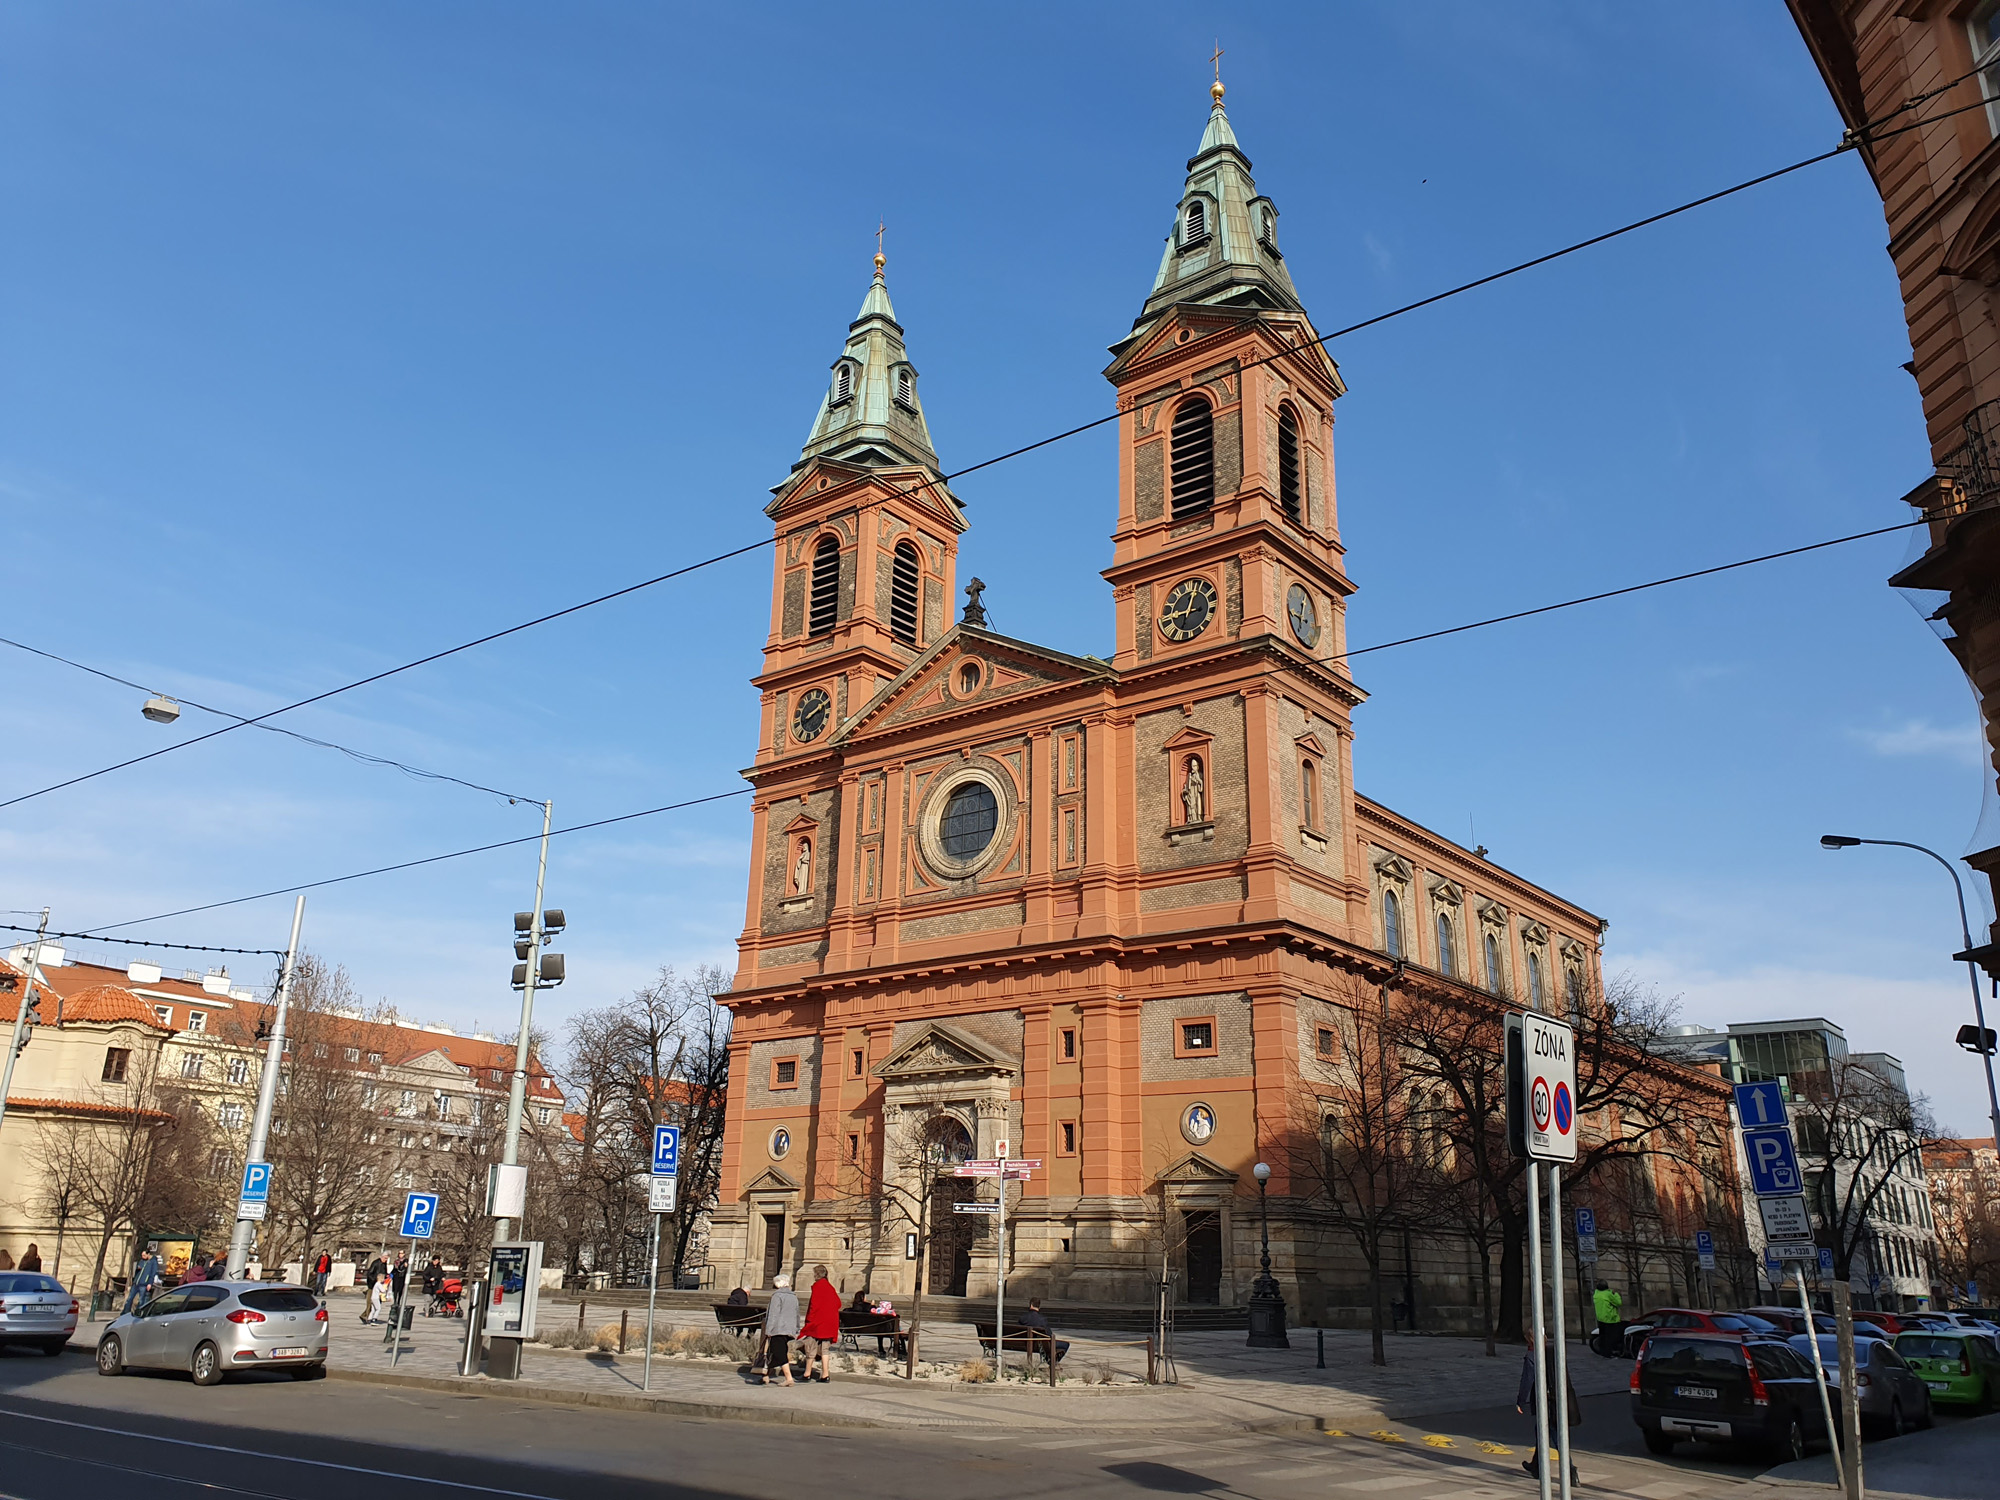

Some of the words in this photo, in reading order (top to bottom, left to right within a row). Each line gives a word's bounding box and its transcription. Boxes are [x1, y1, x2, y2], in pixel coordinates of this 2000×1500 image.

[1534, 1025, 1566, 1062] ZÓNA
[1535, 1090, 1547, 1117] 30
[658, 1131, 674, 1159] P
[1754, 1138, 1782, 1174] P
[247, 1167, 265, 1189] P
[408, 1198, 430, 1223] P
[1579, 1210, 1590, 1226] P
[1699, 1233, 1709, 1247] P
[1821, 1250, 1829, 1261] P
